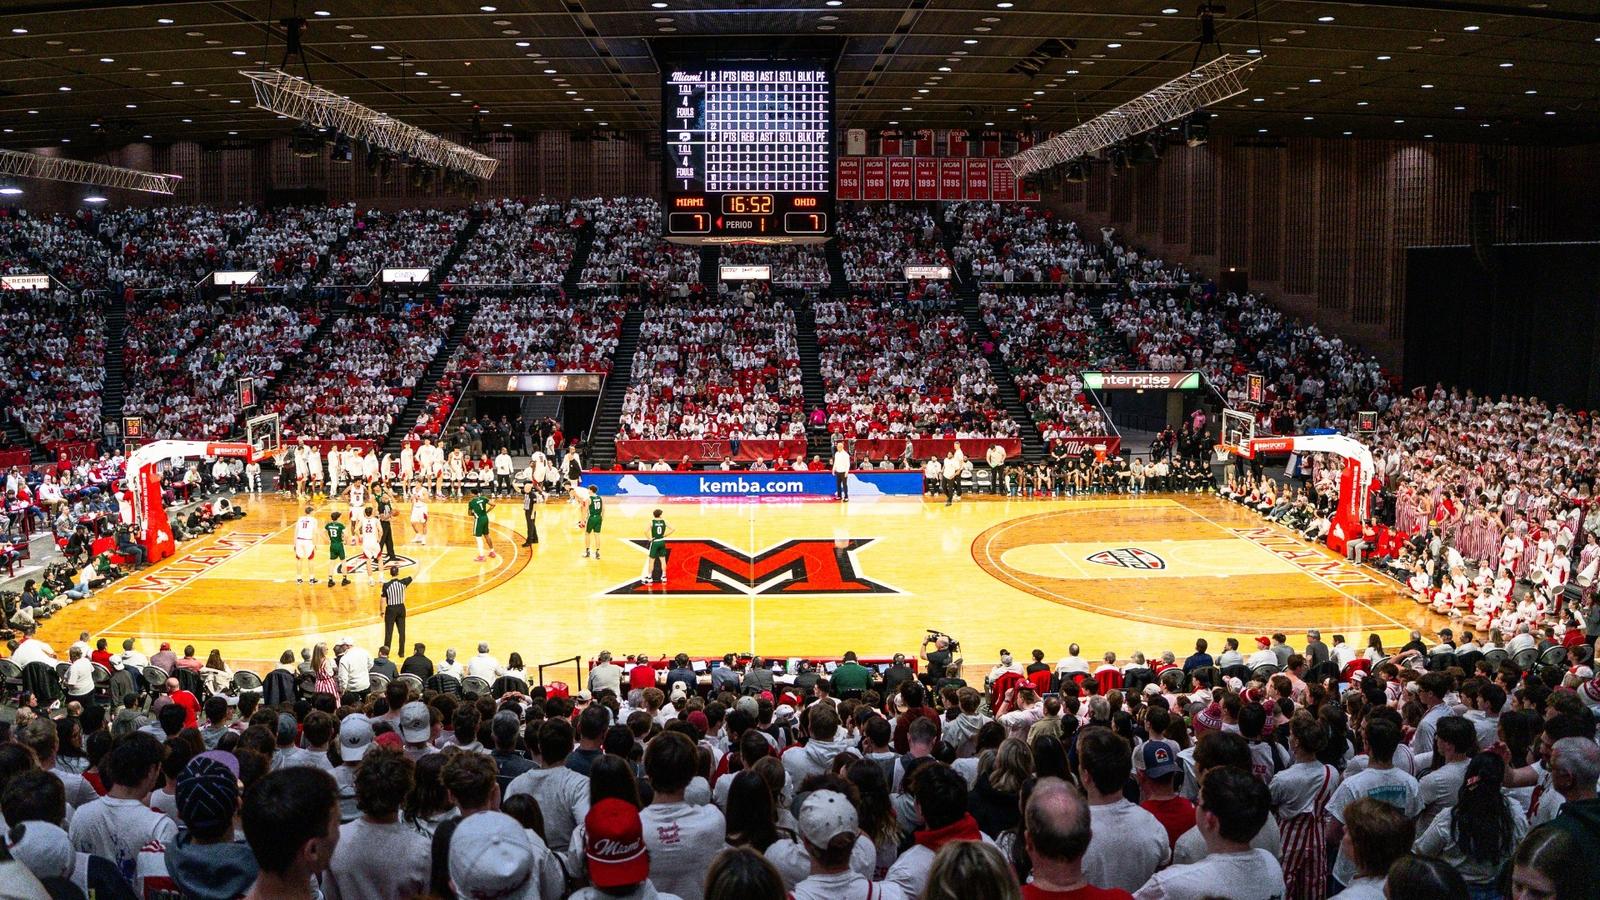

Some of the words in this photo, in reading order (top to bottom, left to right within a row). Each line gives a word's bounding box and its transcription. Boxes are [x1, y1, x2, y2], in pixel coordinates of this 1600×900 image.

[671, 71, 702, 82] Miami
[723, 72, 736, 82] PTS
[741, 72, 754, 82] REB
[760, 72, 774, 82] AST
[779, 72, 792, 82] STL
[798, 72, 811, 82] BLK
[816, 72, 825, 82] PF
[683, 96, 688, 106] 4
[677, 108, 694, 116] FOULS
[684, 119, 687, 129] 1
[723, 132, 736, 142] PTS
[741, 132, 754, 142] REB
[760, 132, 774, 142] AST
[779, 132, 792, 142] STL
[798, 132, 811, 142] BLK
[816, 132, 825, 142] PF
[682, 157, 688, 167] 4
[676, 168, 694, 176] FOULS
[684, 180, 687, 190] 1
[867, 179, 884, 187] 1969
[892, 179, 909, 187] 1978
[918, 179, 936, 187] 1993
[969, 179, 986, 187] 1999
[676, 198, 704, 207] MIAMI
[731, 197, 771, 212] 16:52
[795, 198, 816, 207] OHIO
[694, 215, 703, 230] 7
[726, 221, 752, 229] PERIOD
[761, 218, 764, 232] 1
[809, 215, 818, 230] 7
[700, 477, 803, 493] kemba.com
[330, 529, 337, 537] 13
[657, 526, 662, 534] 0
[1232, 528, 1385, 586] MIAMI
[118, 532, 270, 595] MIAMI
[594, 837, 640, 856] Miami
